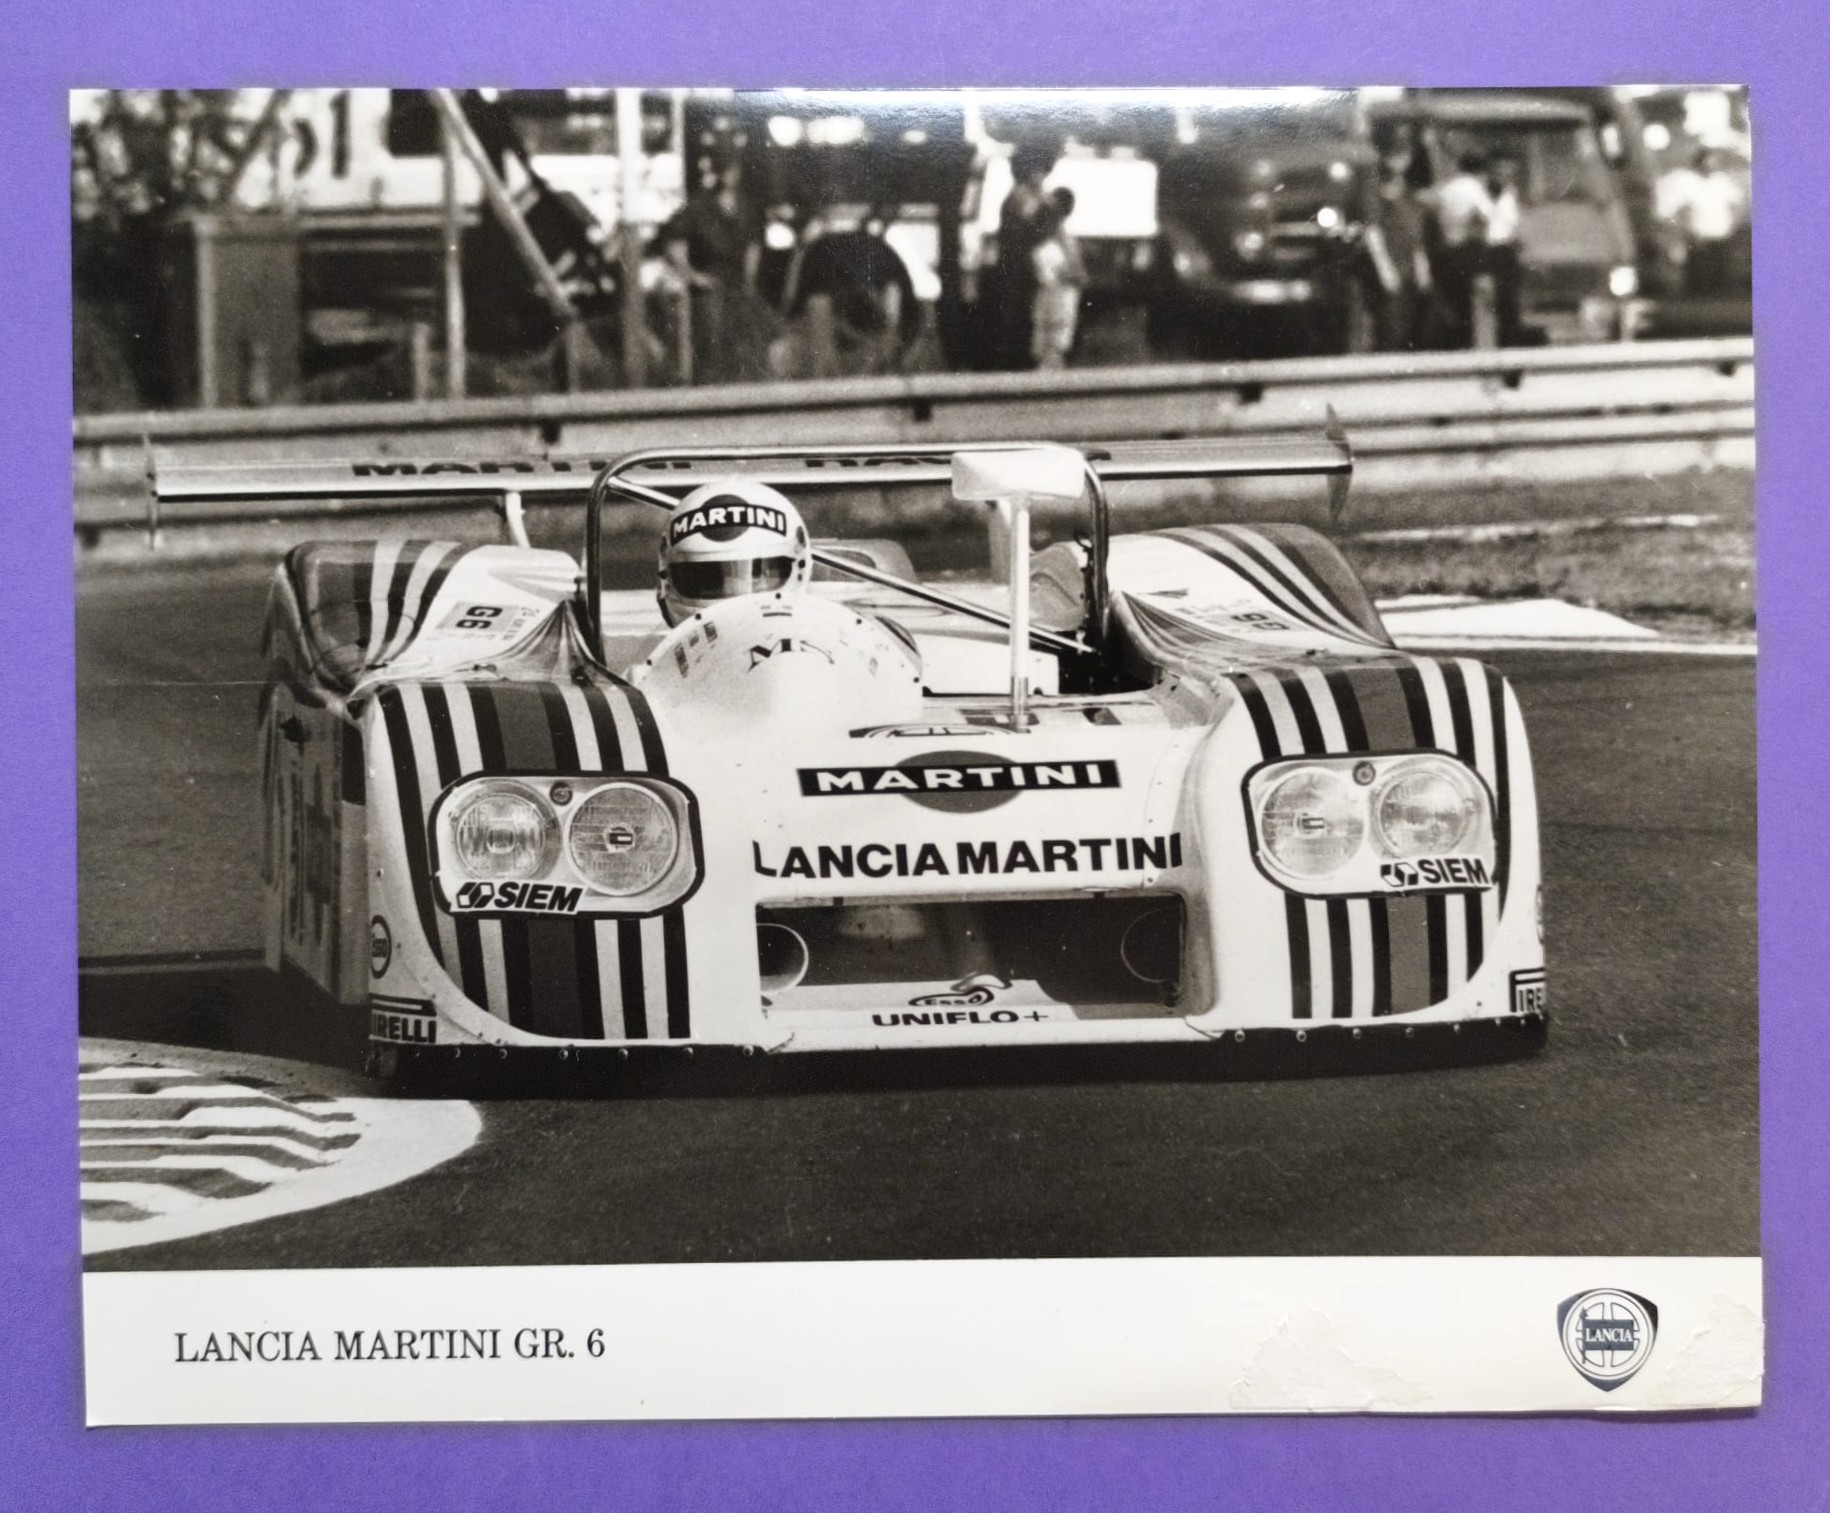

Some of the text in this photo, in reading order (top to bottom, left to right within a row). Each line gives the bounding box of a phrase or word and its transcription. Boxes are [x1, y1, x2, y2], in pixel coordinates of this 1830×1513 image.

[673, 506, 785, 538] MARTINI
[816, 763, 1103, 792] MARTINI
[752, 832, 1184, 879] LANCIA MARTINI
[1418, 857, 1490, 884] SIEM
[494, 881, 583, 912] SIEM
[174, 1327, 607, 1363] LANCIA MARTINI GR. 6
[1585, 1327, 1634, 1343] LANCIA
